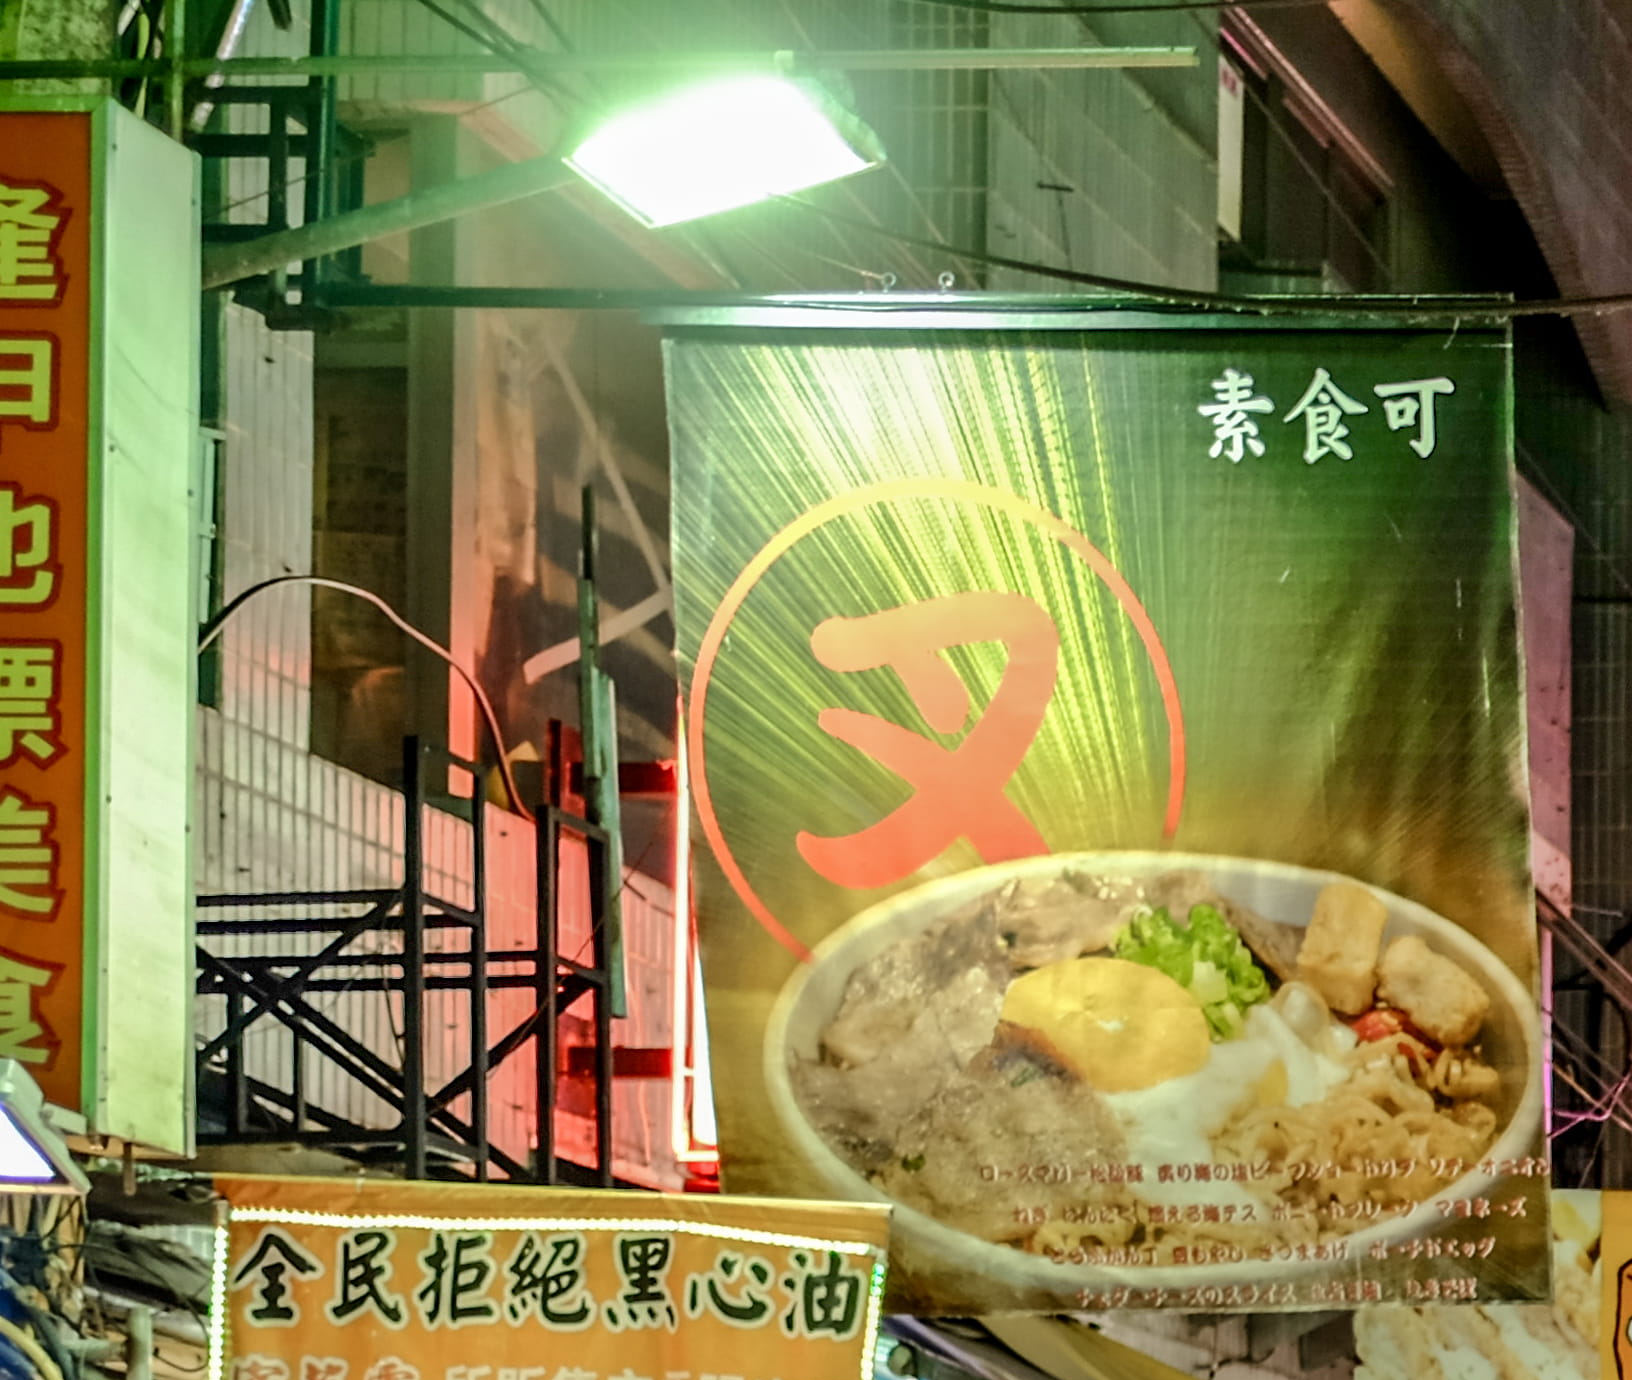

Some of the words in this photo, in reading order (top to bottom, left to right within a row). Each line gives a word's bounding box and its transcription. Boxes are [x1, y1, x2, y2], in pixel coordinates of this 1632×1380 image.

[1198, 367, 1456, 464] 素食可
[232, 1231, 862, 1338] 全民拒絕黑心油
